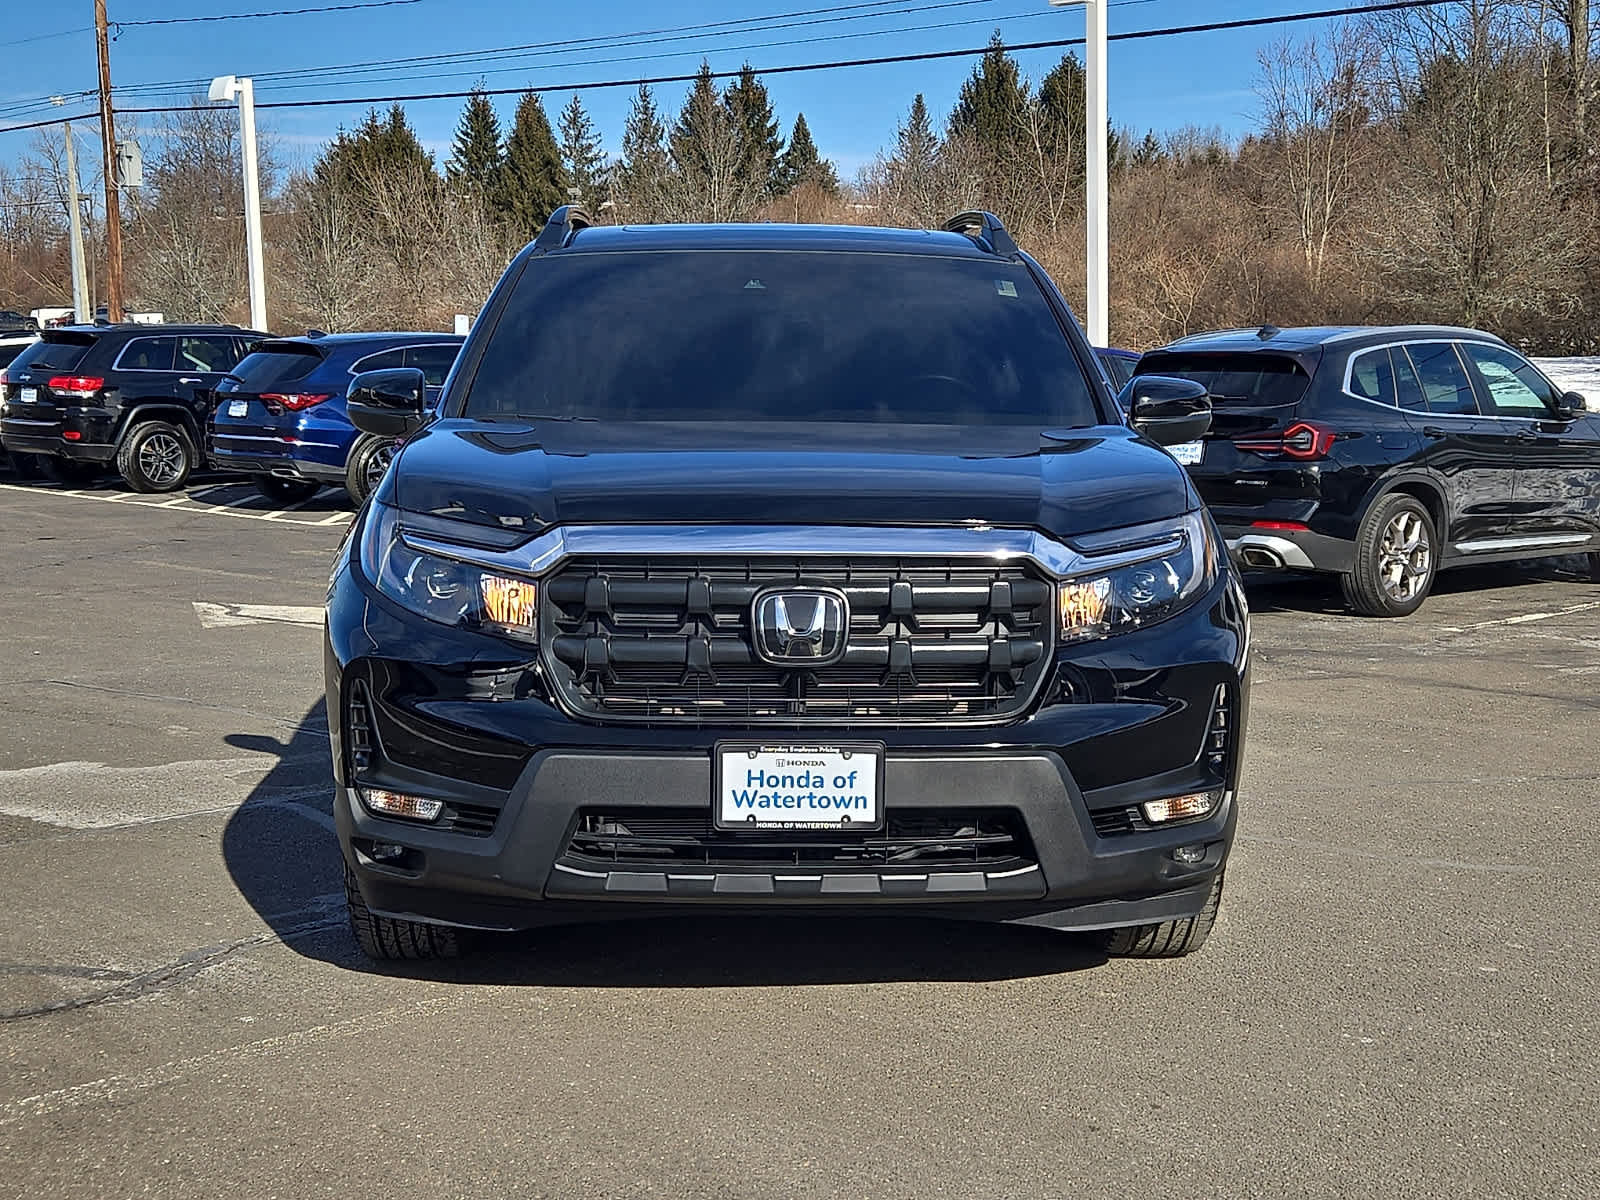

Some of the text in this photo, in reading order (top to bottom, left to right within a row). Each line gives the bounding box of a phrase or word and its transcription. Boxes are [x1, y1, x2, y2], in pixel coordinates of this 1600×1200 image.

[746, 769, 858, 788] Honda of
[731, 789, 867, 809] Watertown
